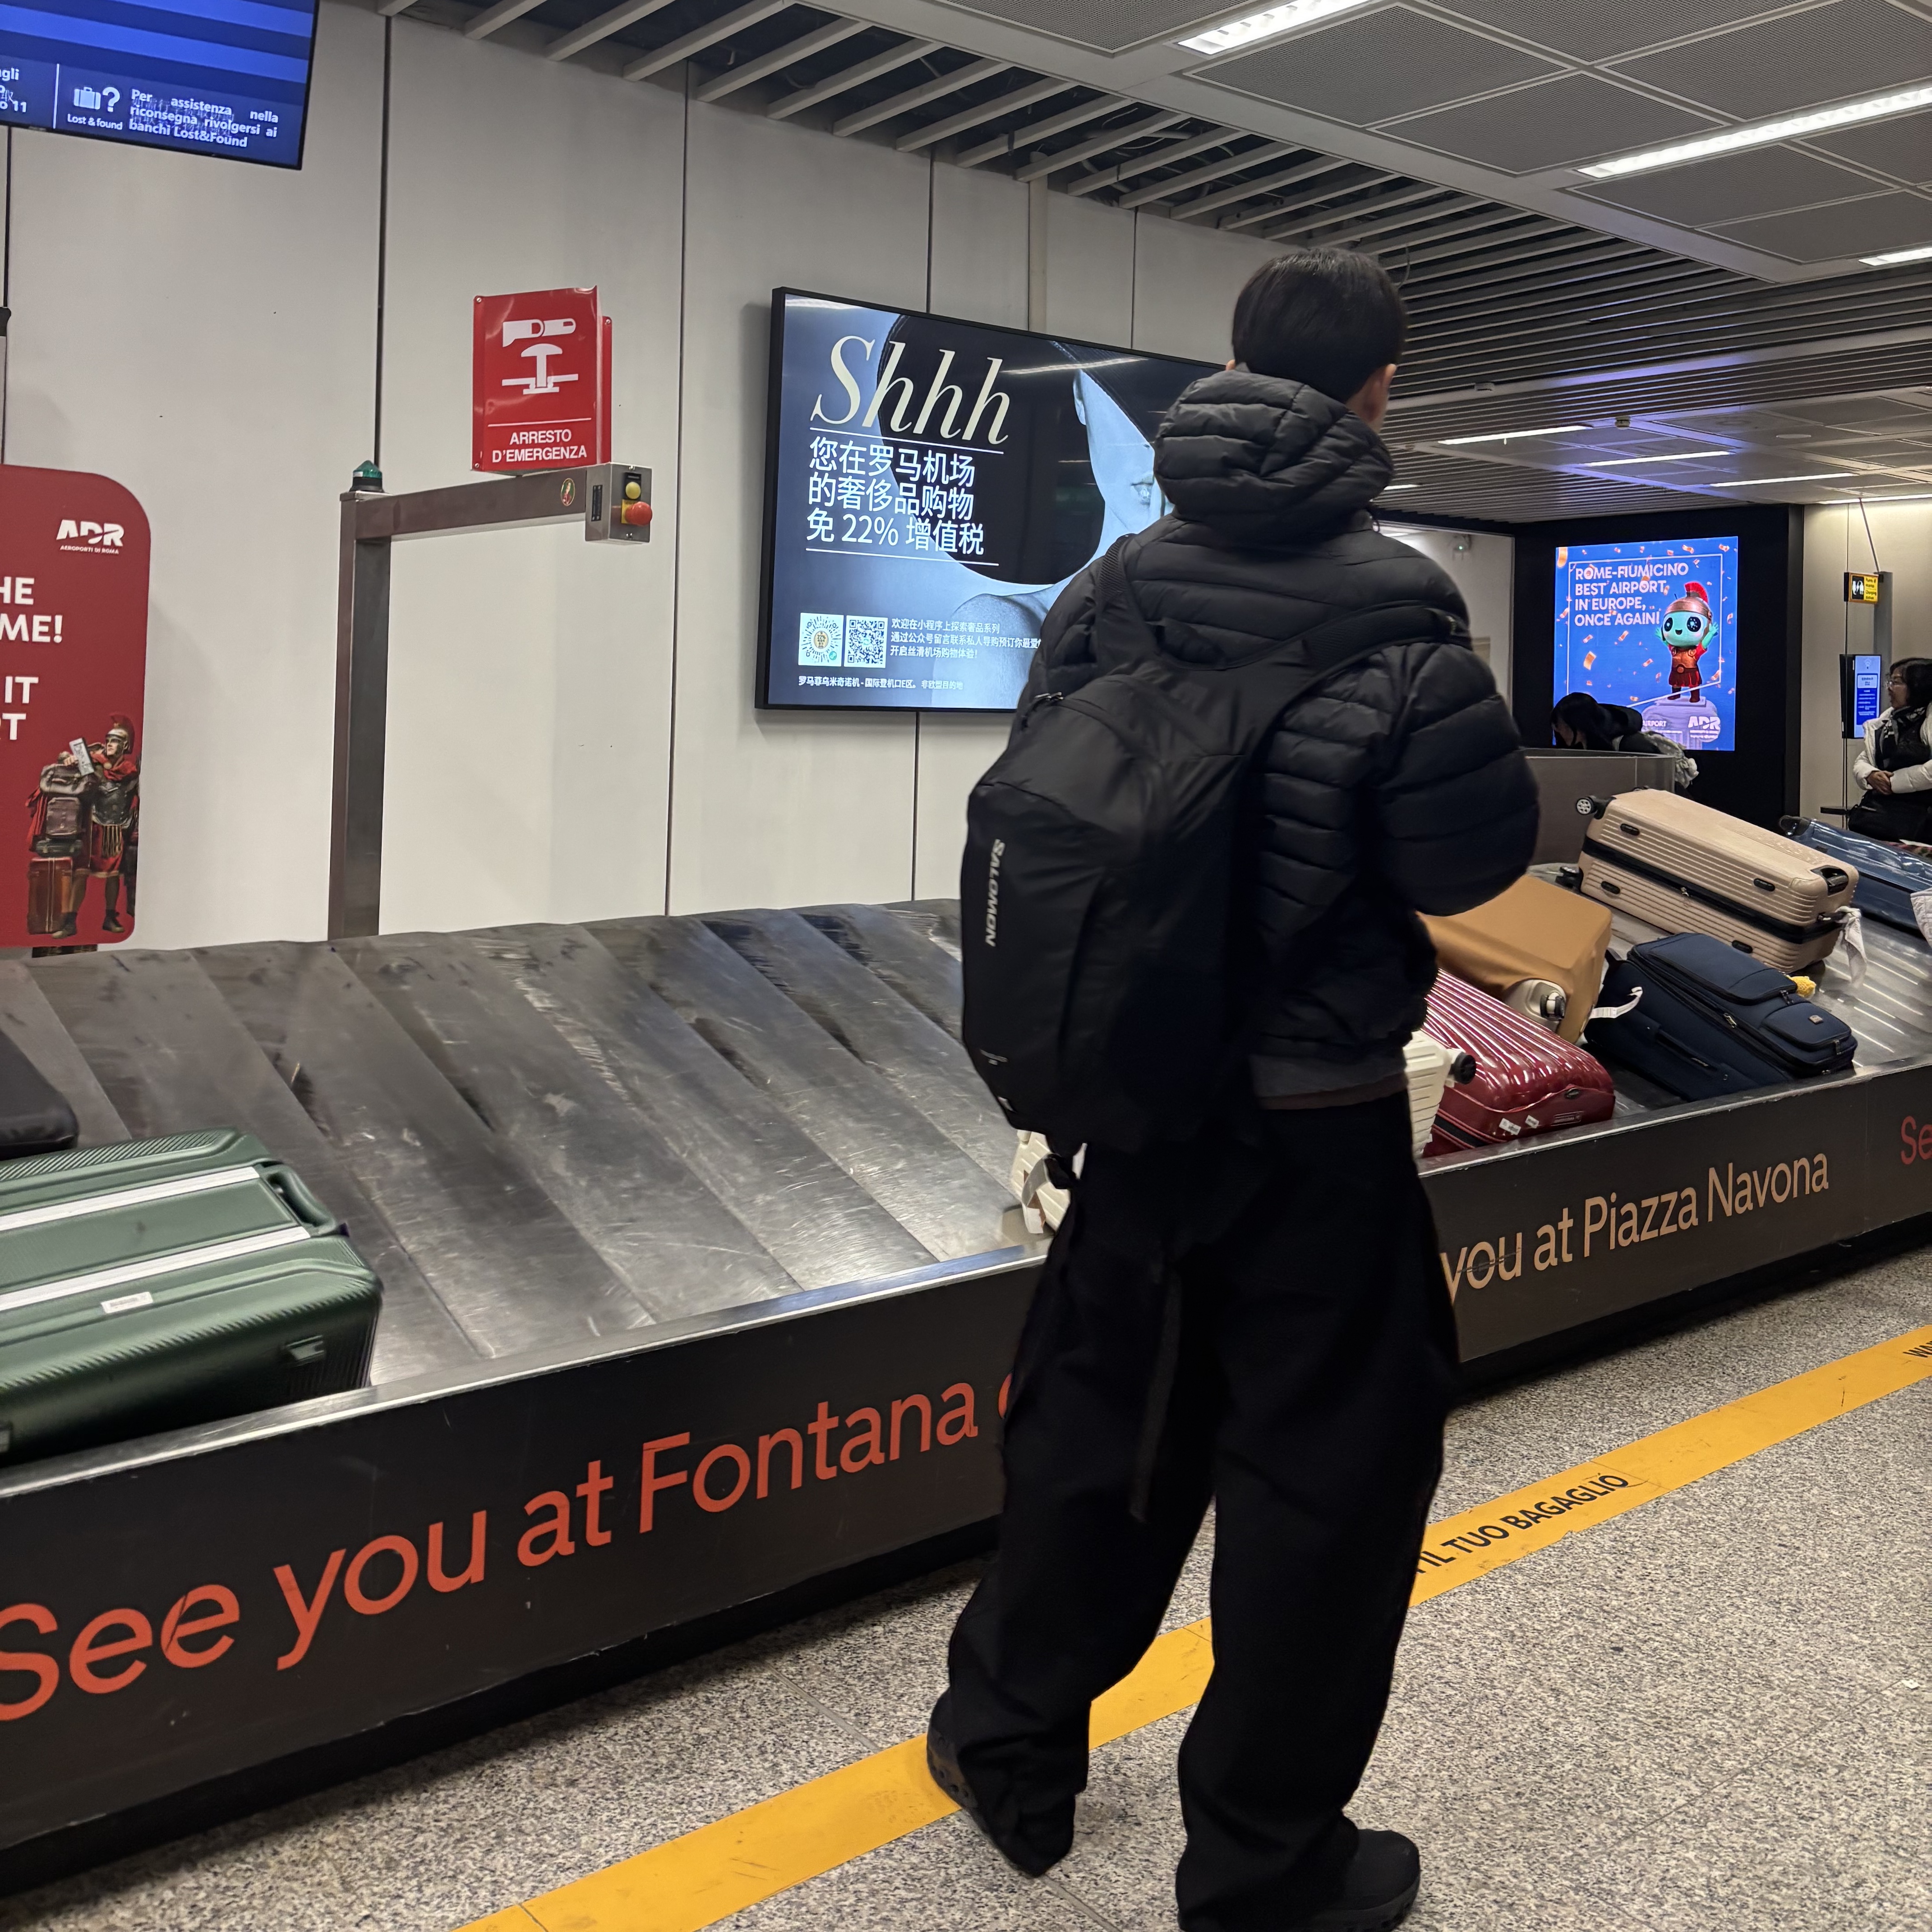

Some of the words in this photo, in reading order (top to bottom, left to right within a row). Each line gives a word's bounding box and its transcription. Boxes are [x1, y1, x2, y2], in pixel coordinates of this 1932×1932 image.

[131, 88, 153, 102] Per
[171, 97, 232, 115] assistenza
[249, 110, 279, 123] nella
[67, 113, 86, 125] Lost
[88, 117, 96, 126] &
[96, 117, 123, 130] found
[129, 118, 171, 136] banchi
[173, 125, 248, 147] Lost&Found
[130, 104, 198, 125] riconsegna
[204, 116, 261, 135] rivolgersi
[265, 126, 277, 138] ai
[810, 335, 1010, 445] Shhh
[509, 428, 572, 446] ARRESTO
[492, 445, 587, 463] D'EMERGENZA
[809, 435, 976, 488] 您在罗马机场
[808, 472, 974, 521] 的奢侈品购物
[56, 519, 124, 547] ADR
[1575, 562, 1689, 580] ROME-FIUMICINO
[1575, 582, 1606, 596] BEST
[1609, 580, 1667, 594] AIRPORT
[1575, 598, 1588, 611] IN
[1591, 596, 1646, 611] EUROPE,
[1574, 613, 1611, 626] ONCE
[1688, 716, 1721, 730] ADR
[985, 838, 1006, 947] SALOMON
[1440, 1232, 1522, 1303] you
[1534, 1208, 1573, 1271] at
[1584, 1192, 1698, 1257] Piazza
[1708, 1153, 1829, 1222] Navona
[1440, 1525, 1510, 1554] TUO
[1499, 1475, 1629, 1530] BAGAGLIO
[0, 1584, 240, 1720] See
[273, 1510, 486, 1670] you
[517, 1460, 613, 1566] at
[640, 1382, 978, 1533] Fontana
